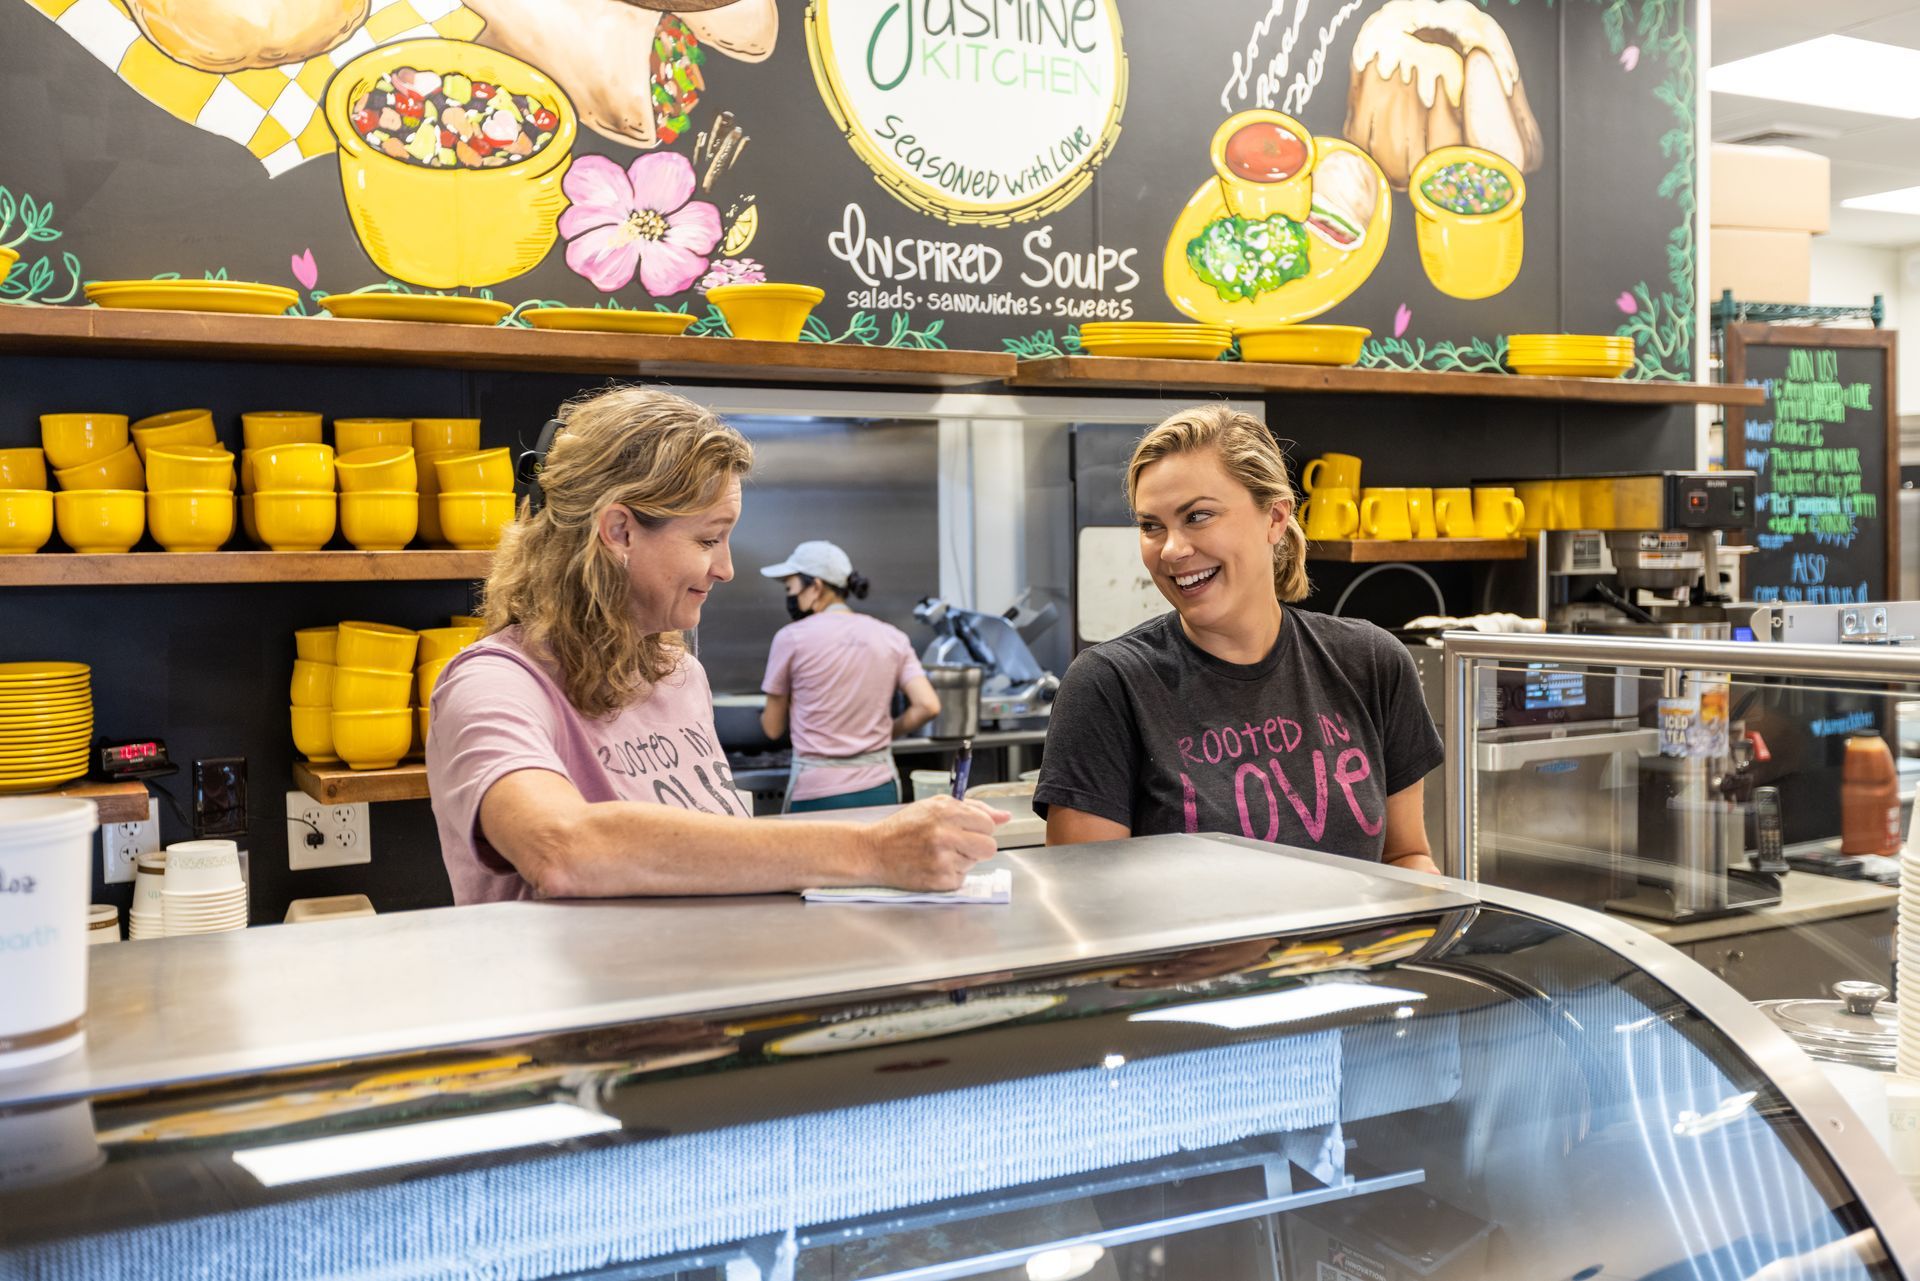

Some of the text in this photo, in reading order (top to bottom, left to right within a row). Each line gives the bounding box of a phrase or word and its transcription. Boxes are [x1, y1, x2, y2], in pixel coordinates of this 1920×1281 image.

[922, 38, 1100, 96] KITCHEN
[846, 284, 916, 311] salads
[1053, 296, 1134, 320] sweets
